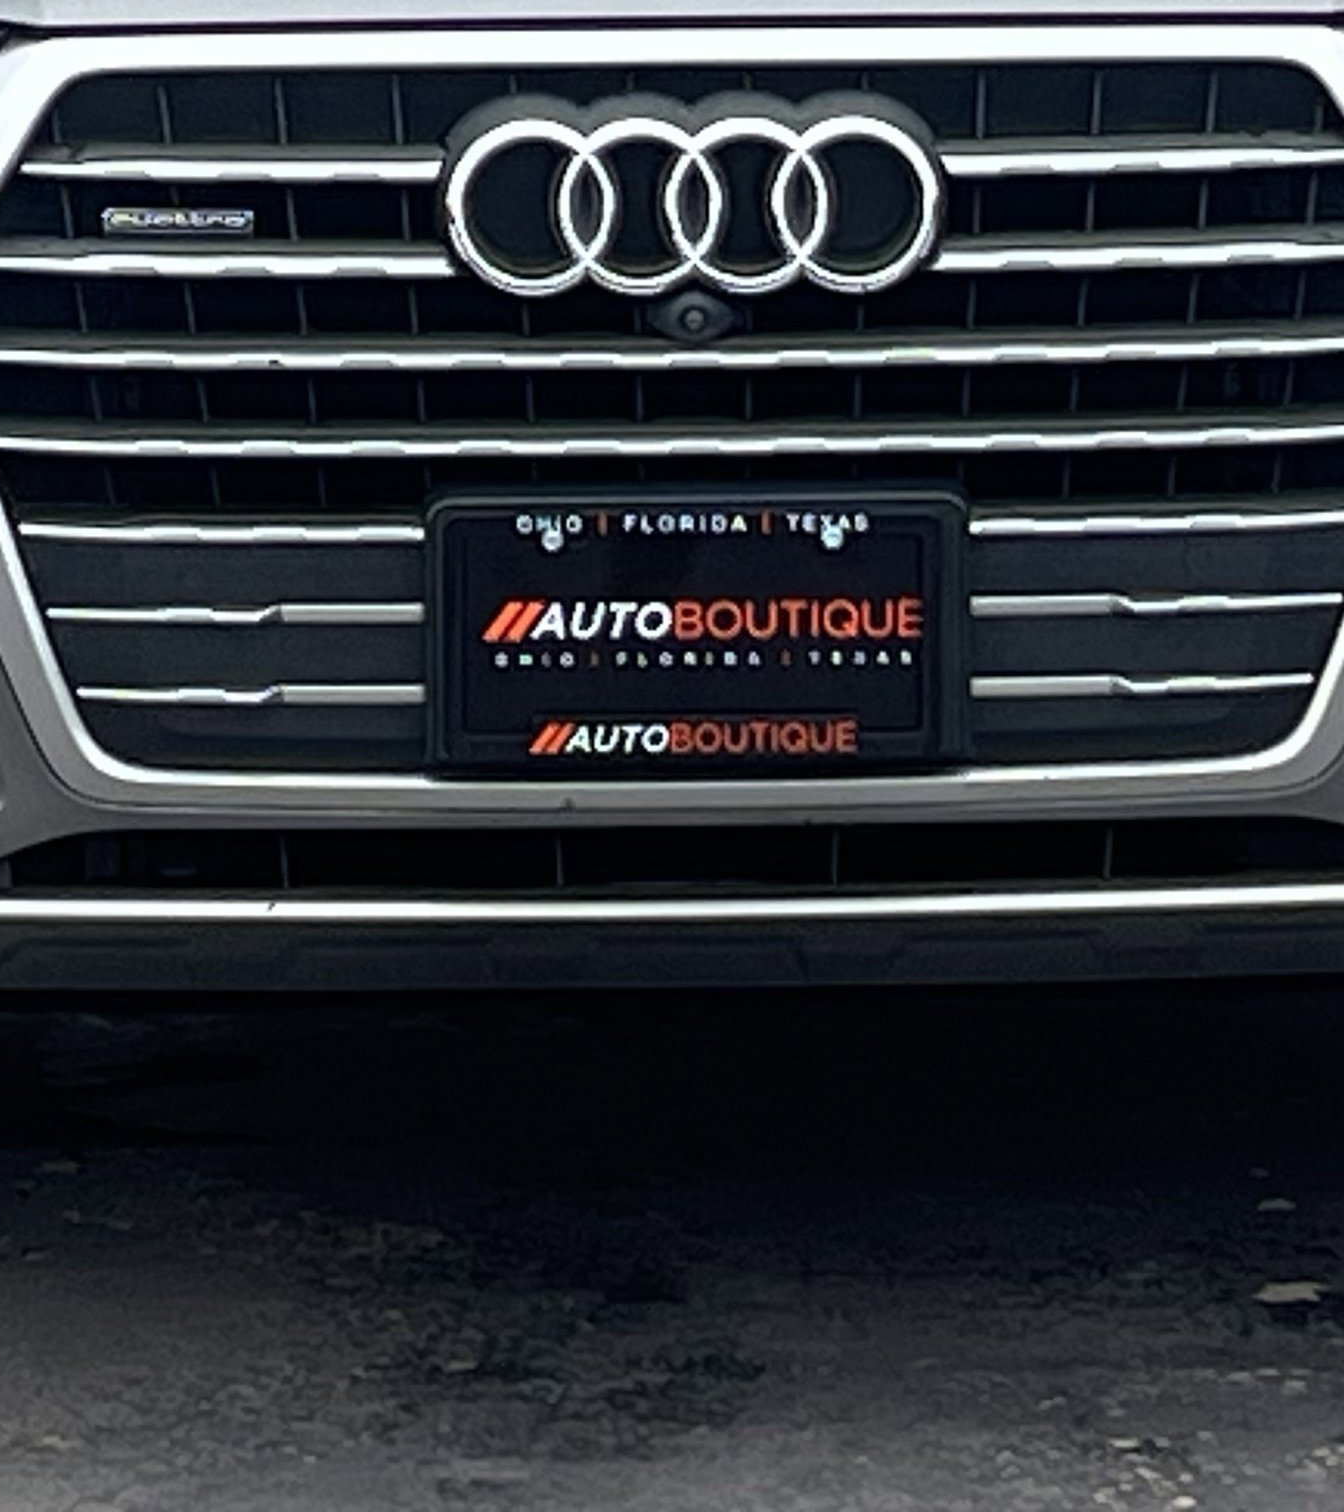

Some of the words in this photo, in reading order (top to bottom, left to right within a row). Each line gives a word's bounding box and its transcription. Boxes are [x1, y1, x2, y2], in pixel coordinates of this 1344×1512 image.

[622, 513, 748, 534] FLORIDA
[786, 513, 870, 534] TEXAS
[531, 599, 924, 641] AUTOBOUTIQUE
[565, 721, 858, 755] AUTOBOUTIQUE
